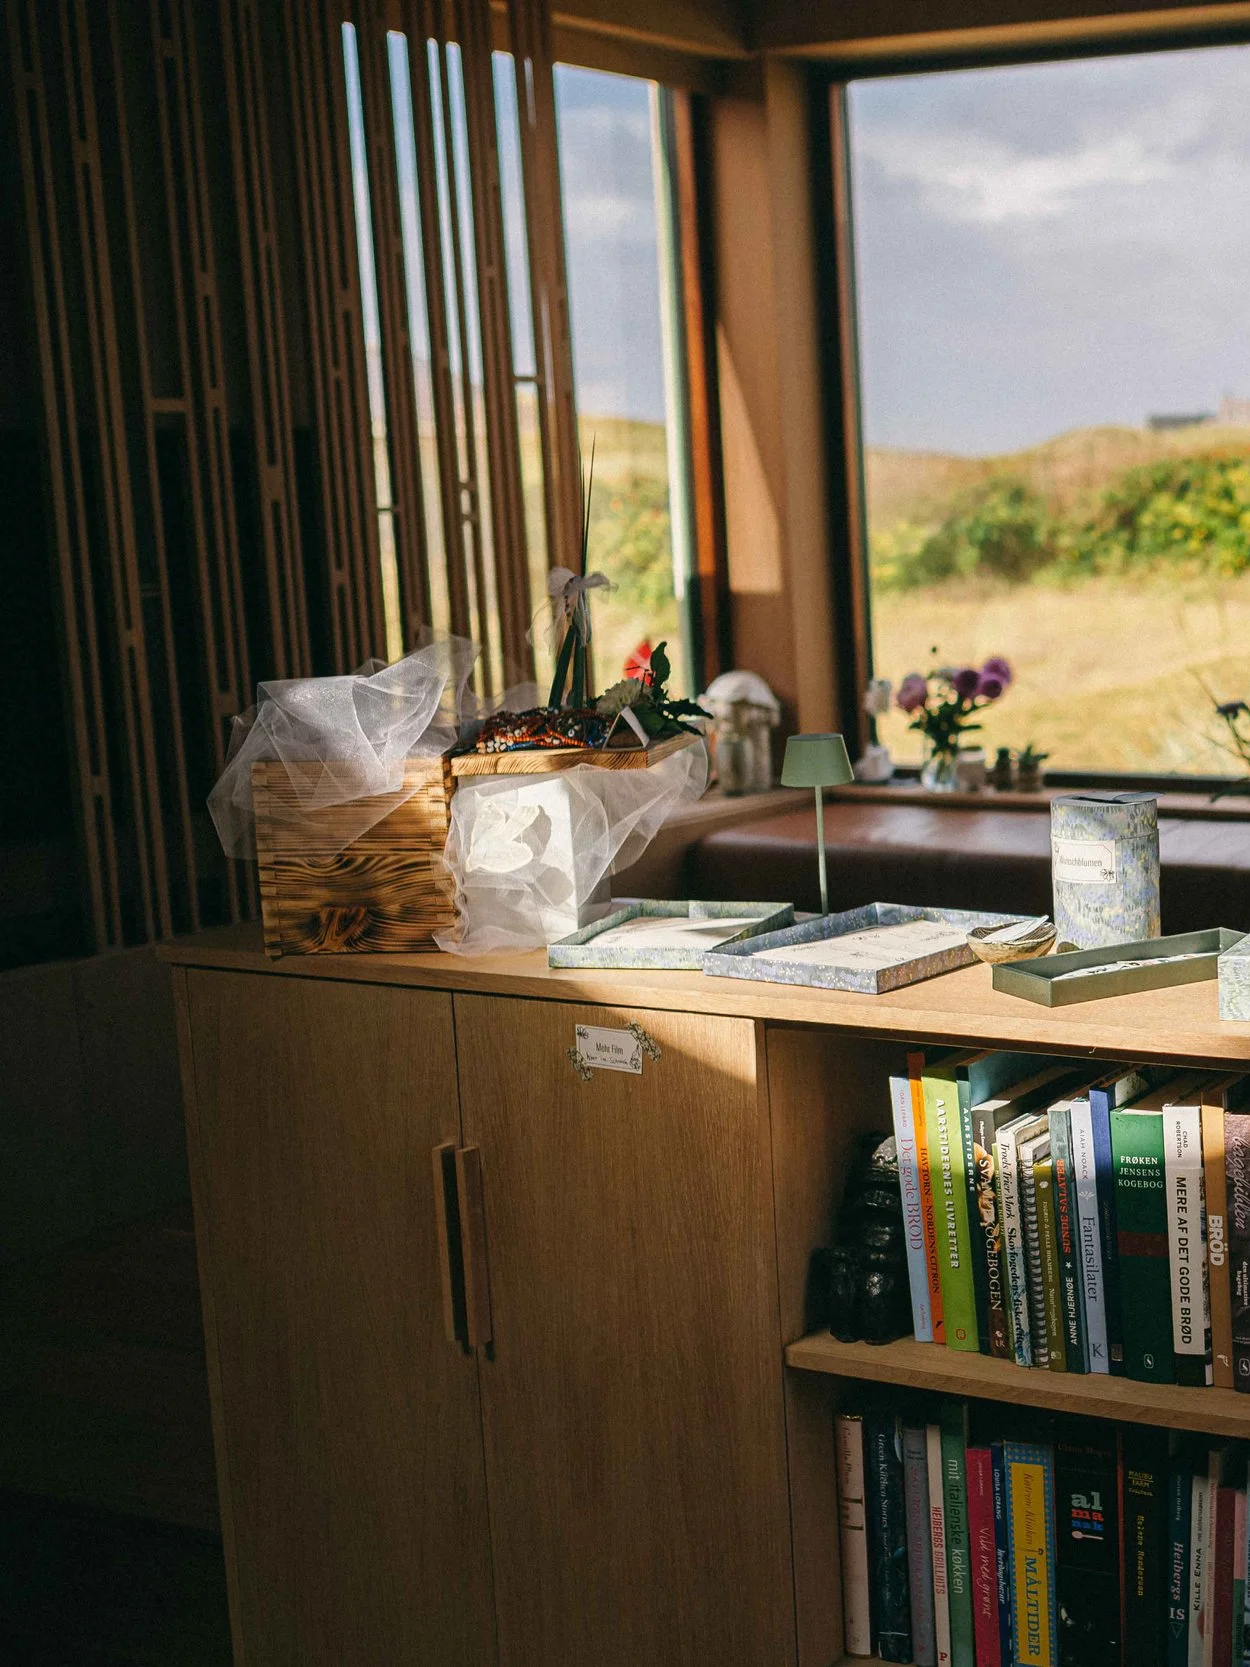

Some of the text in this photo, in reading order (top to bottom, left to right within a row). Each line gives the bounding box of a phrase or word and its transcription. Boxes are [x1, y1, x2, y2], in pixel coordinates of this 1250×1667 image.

[611, 1045, 624, 1056] Film
[963, 1107, 975, 1192] AARSTIDERNE
[1175, 1120, 1183, 1158] ROBERTSON
[1000, 1143, 1011, 1171] Troels
[1120, 1156, 1158, 1165] FRØKEN
[935, 1099, 960, 1269] AARSTIDERNES LIVRETTER
[1002, 1171, 1013, 1195] Trier
[1118, 1179, 1164, 1189] KOGEBOG
[1119, 1167, 1161, 1177] JENSENS
[901, 1139, 923, 1250] Det gode BRØD
[920, 1148, 941, 1294] HAVTORN NORDENS CITRON
[1208, 1215, 1229, 1266] BRÖD
[1007, 1227, 1020, 1296] Skovfogedens
[1082, 1217, 1099, 1302] Fantasilater
[1176, 1177, 1192, 1344] MERE AF DET GODE BRØD
[1065, 1276, 1076, 1318] HJERNØE
[1069, 1320, 1078, 1346] ANNE
[877, 1433, 887, 1461] Green
[1070, 1491, 1103, 1511] al
[1071, 1508, 1104, 1522] ma
[931, 1506, 944, 1548] HEIBERGS
[948, 1459, 968, 1594] mit italienske køkken
[979, 1527, 992, 1552] Vild
[1071, 1519, 1104, 1532] nak
[981, 1555, 993, 1580] med
[1170, 1542, 1184, 1600] Heibergs
[1025, 1555, 1042, 1656] MÅLTIDER
[1193, 1582, 1201, 1611] KILLE
[1168, 1607, 1185, 1620] IS
